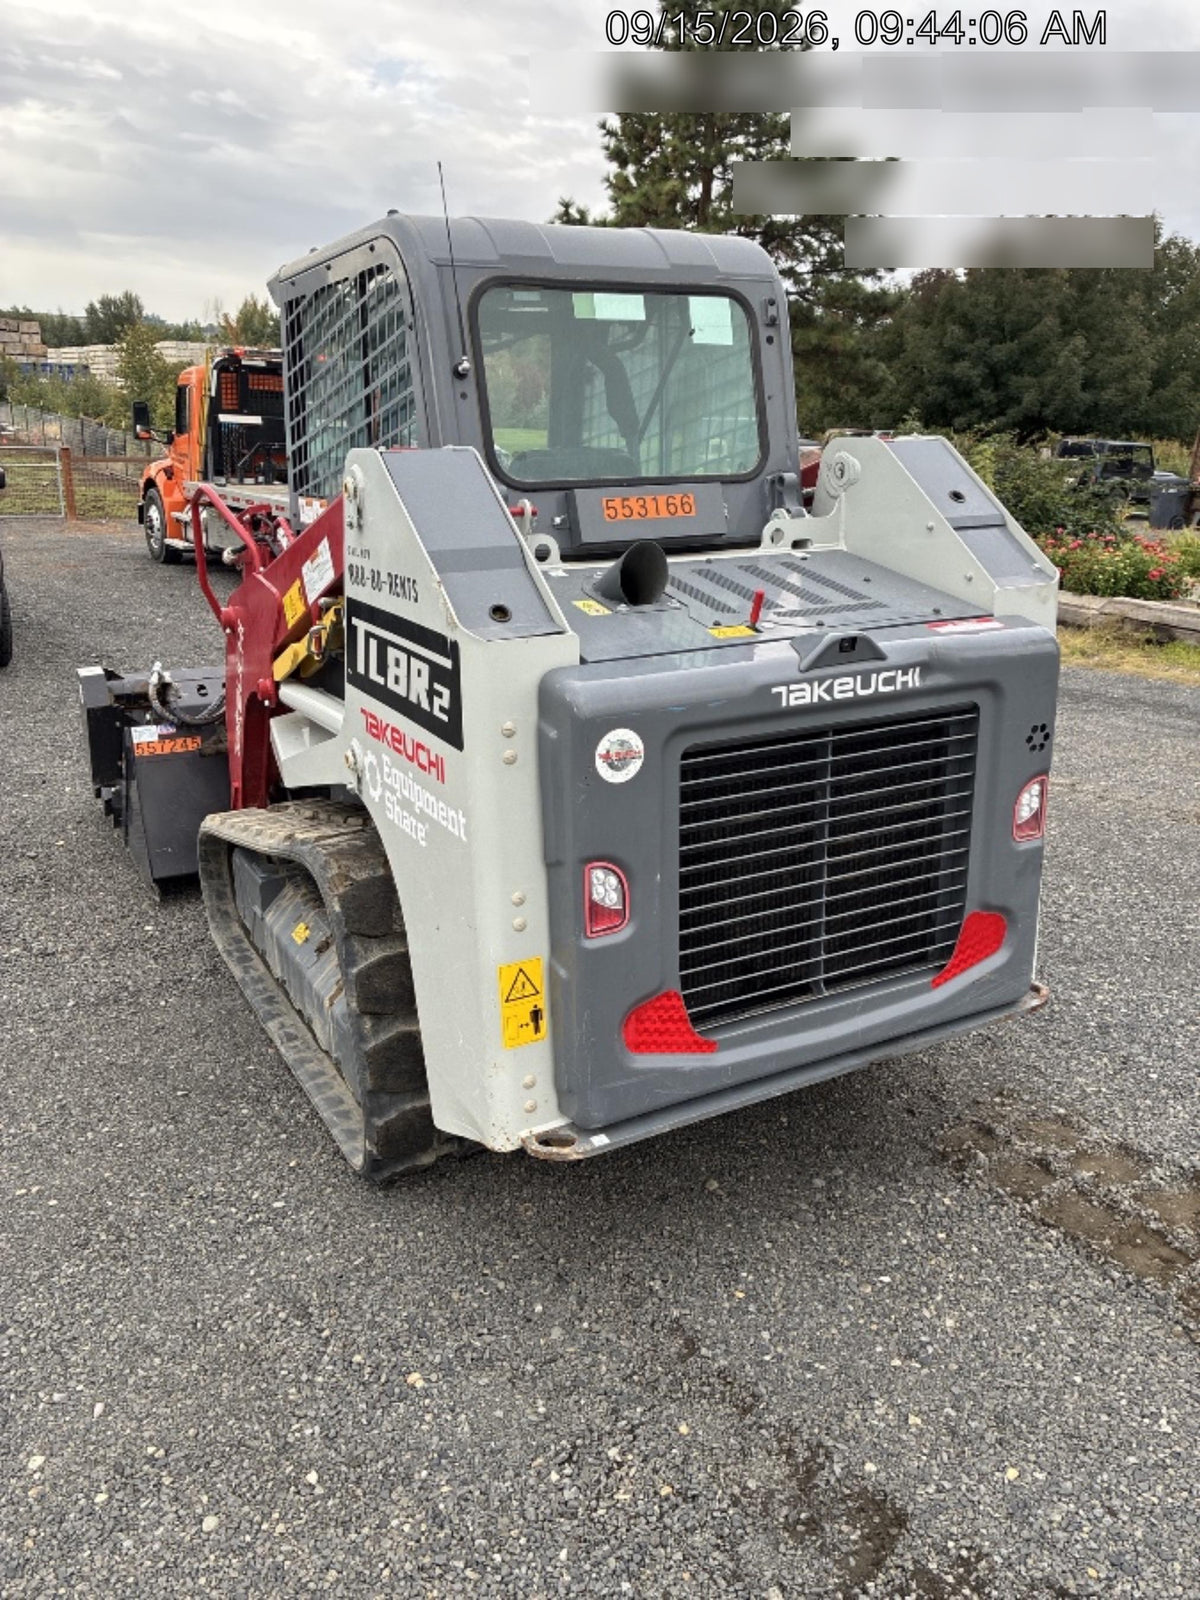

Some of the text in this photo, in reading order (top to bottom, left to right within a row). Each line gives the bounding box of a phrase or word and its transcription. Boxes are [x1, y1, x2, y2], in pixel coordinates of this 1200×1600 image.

[605, 494, 693, 519] 553166
[351, 616, 452, 722] TL8R2
[381, 752, 467, 842] Equipment
[384, 789, 427, 847] Share
